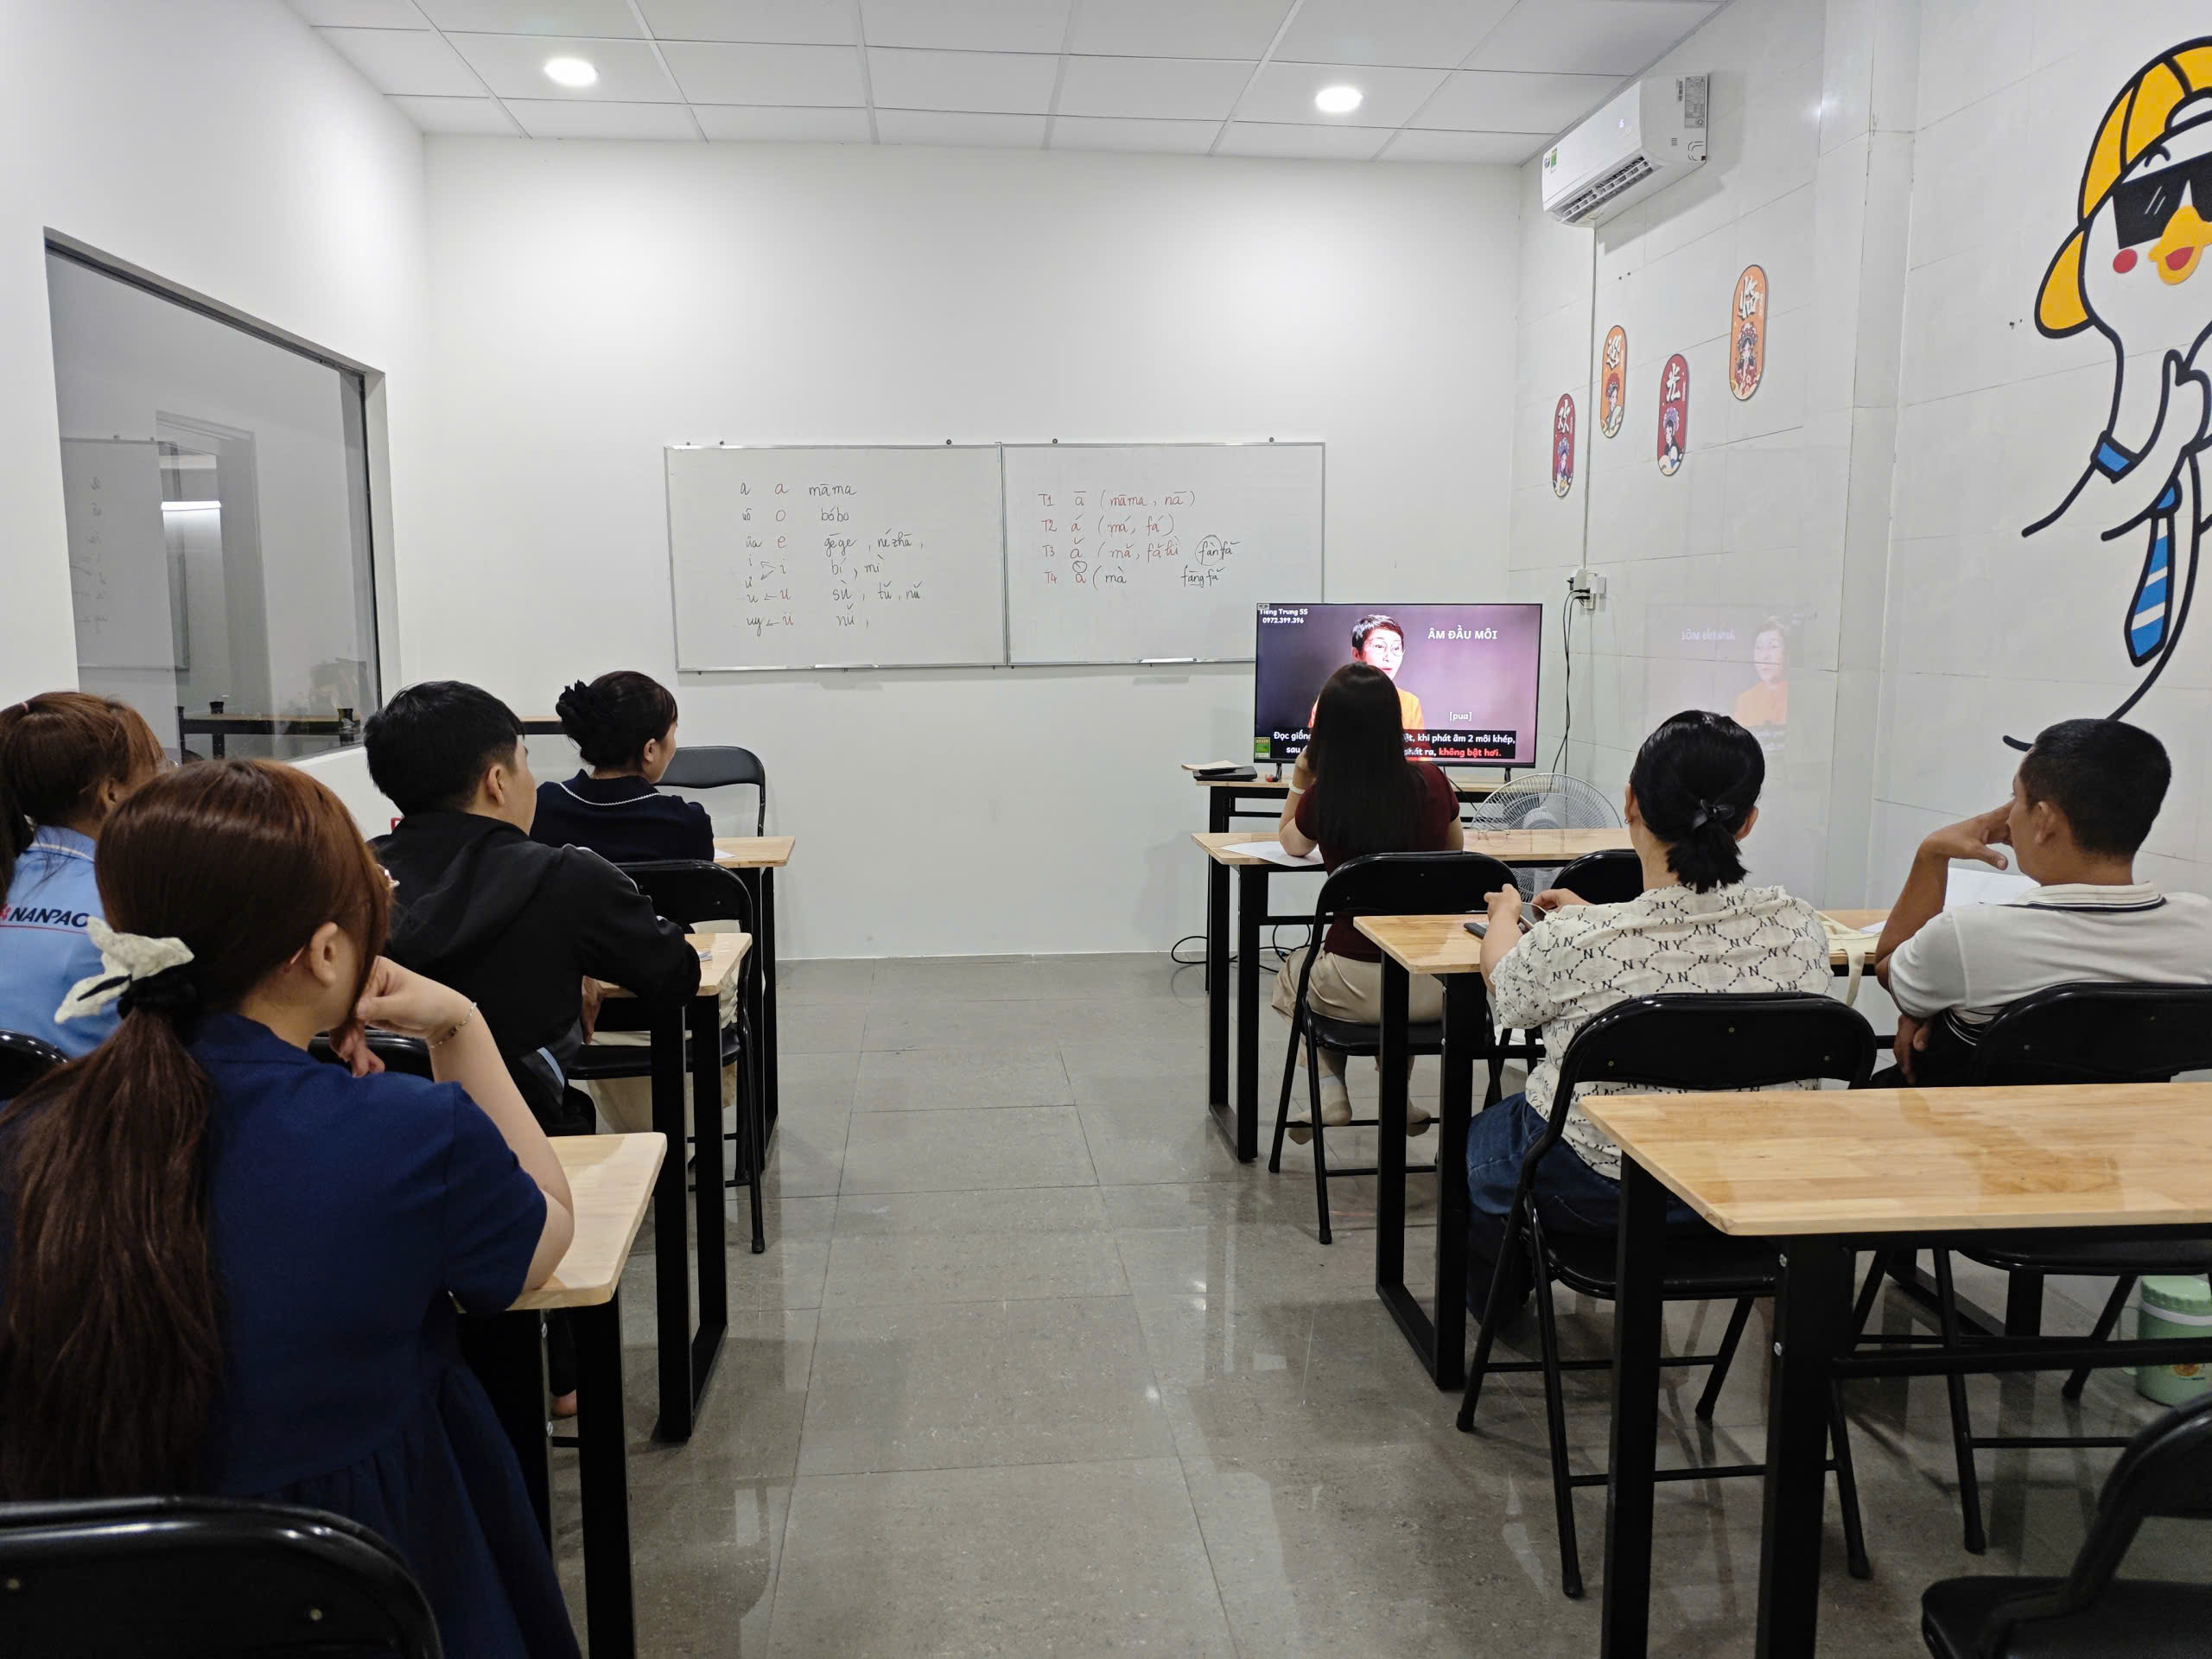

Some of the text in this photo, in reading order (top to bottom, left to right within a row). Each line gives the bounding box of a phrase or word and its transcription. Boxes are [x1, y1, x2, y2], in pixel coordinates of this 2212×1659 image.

[1666, 362, 1681, 402] 光
[740, 482, 752, 495] a
[774, 483, 789, 495] a
[1038, 493, 1056, 506] T1
[1040, 519, 1058, 532] T2
[777, 535, 788, 549] e
[1042, 544, 1056, 558] T3
[1044, 570, 1057, 584] T4
[1427, 624, 1498, 639] ÂM ĐẦU MÔI
[1449, 711, 1472, 721] [pua]
[1274, 731, 1290, 741] Đọc
[1417, 733, 1430, 742] khi
[1431, 733, 1452, 744] phát
[1452, 734, 1466, 742] âm
[1467, 734, 1474, 742] 2
[1475, 734, 1491, 743] môi
[1438, 747, 1465, 758] không
[1466, 747, 1483, 758] bật
